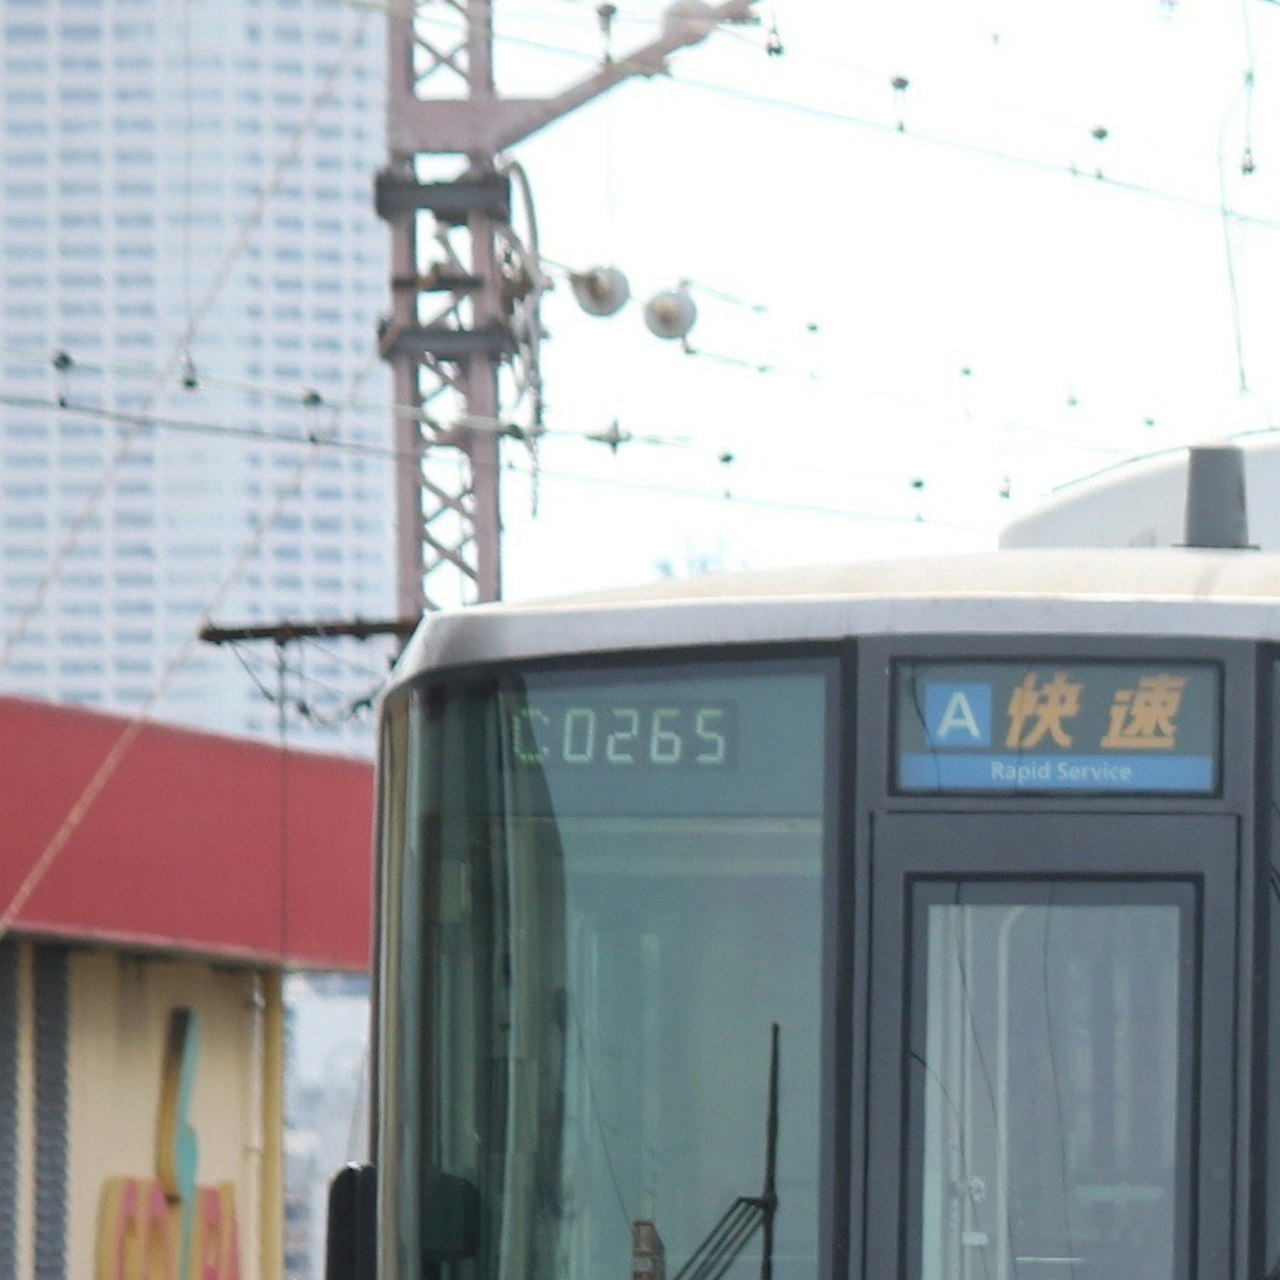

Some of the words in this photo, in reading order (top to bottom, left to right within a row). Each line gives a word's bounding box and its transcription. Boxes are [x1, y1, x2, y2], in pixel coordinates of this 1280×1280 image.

[935, 691, 982, 739] A
[1005, 672, 1190, 749] 快速
[991, 761, 1051, 783] Rapid
[1056, 761, 1132, 781] Service
